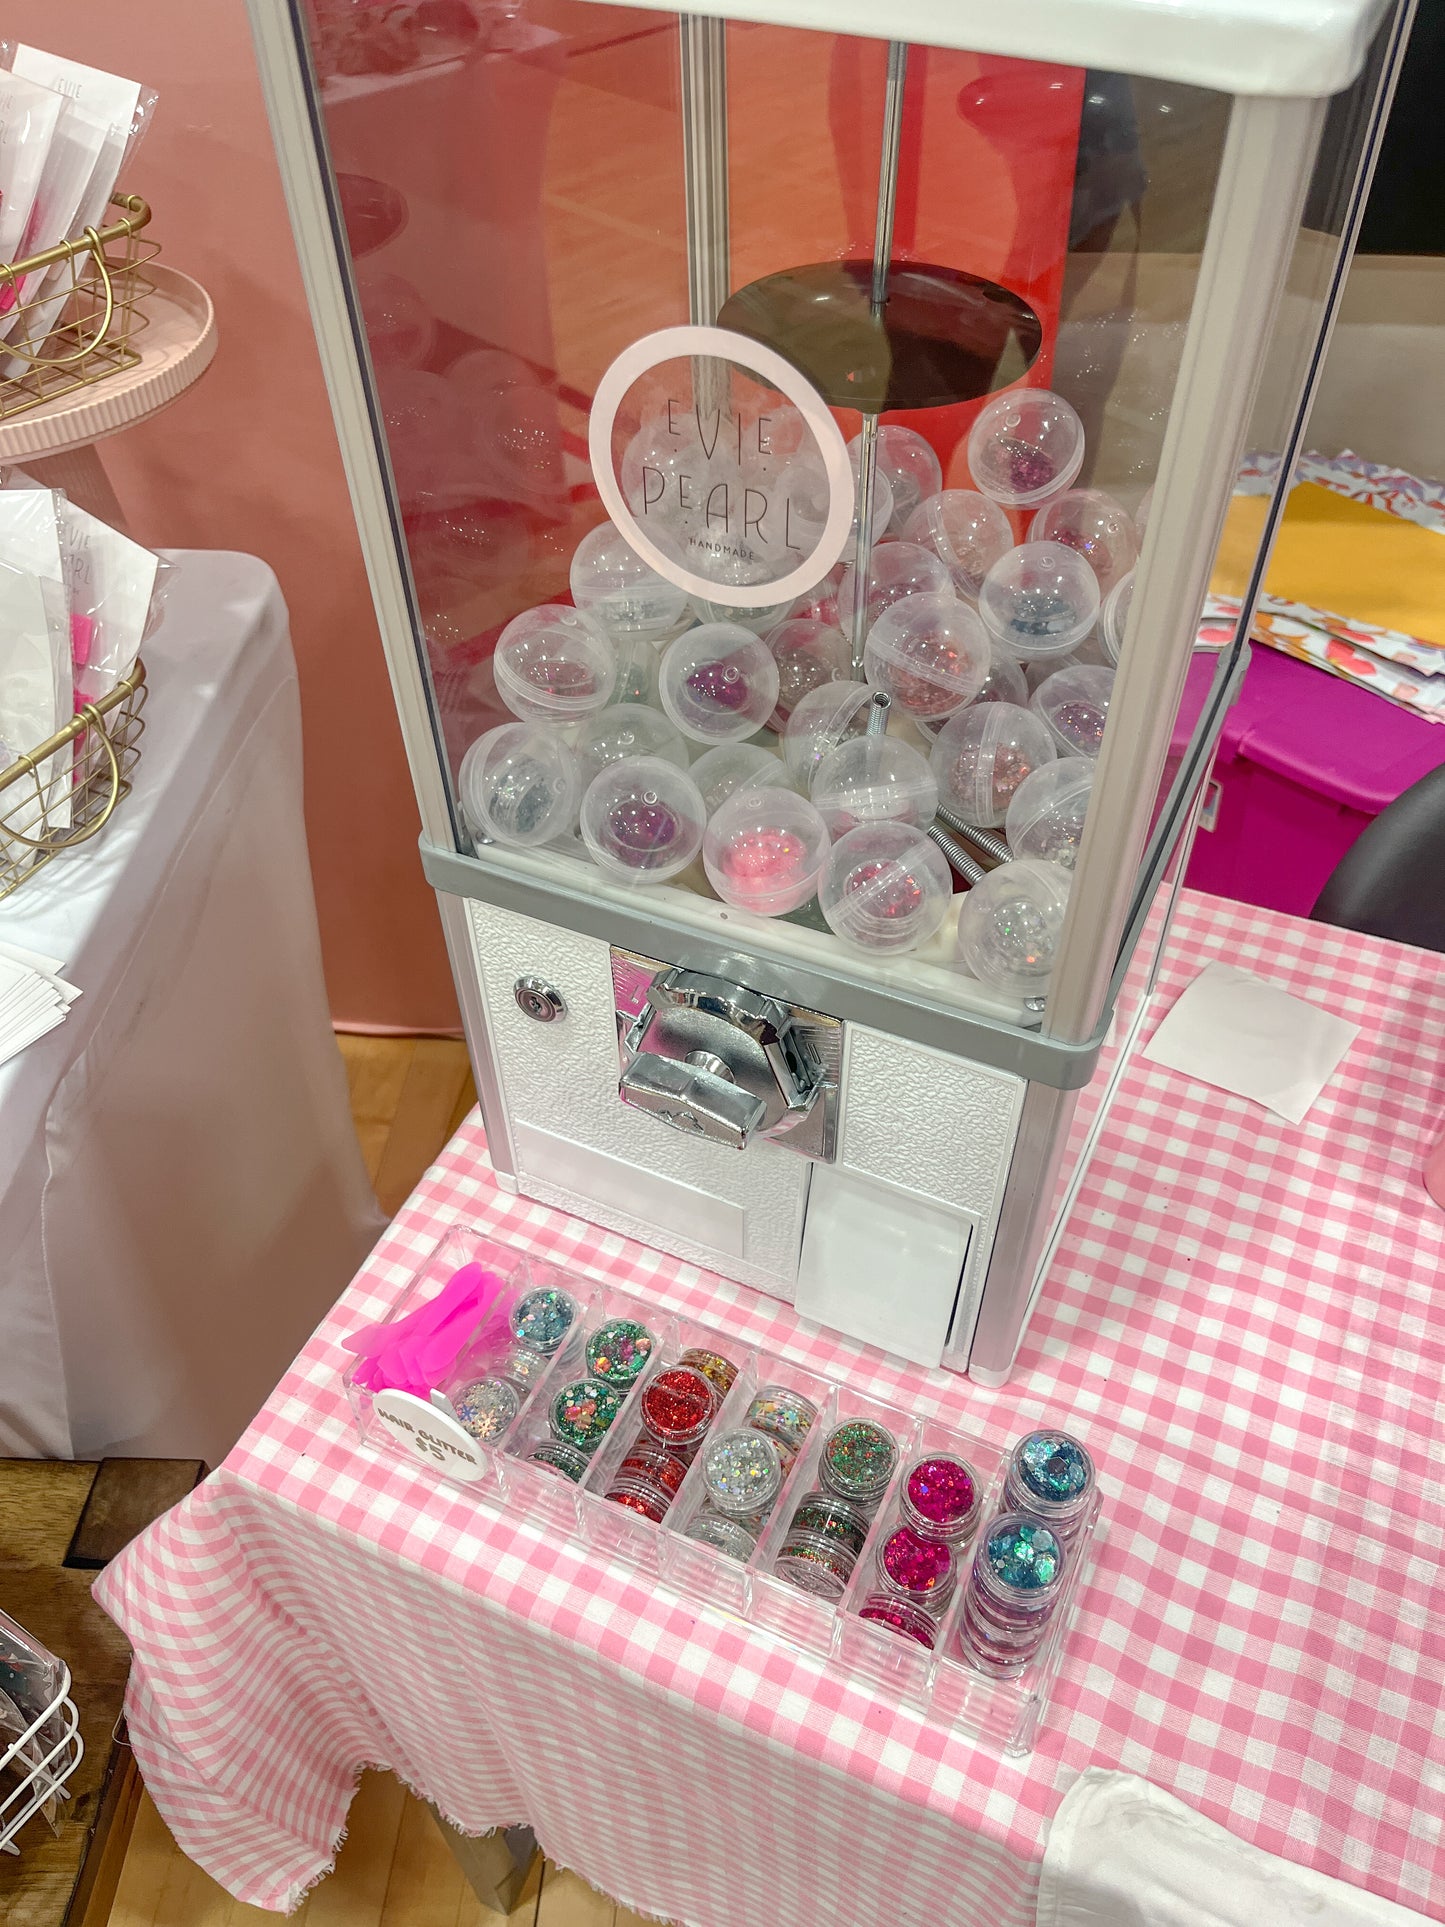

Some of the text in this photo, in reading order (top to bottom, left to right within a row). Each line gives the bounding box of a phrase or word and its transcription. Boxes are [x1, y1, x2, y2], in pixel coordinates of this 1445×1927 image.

[667, 399, 772, 466] EVIE
[642, 466, 801, 550] PEARL
[689, 537, 754, 561] HANDMADE
[377, 1407, 477, 1465] HAIR GLITTER
[415, 1436, 446, 1461] $5
